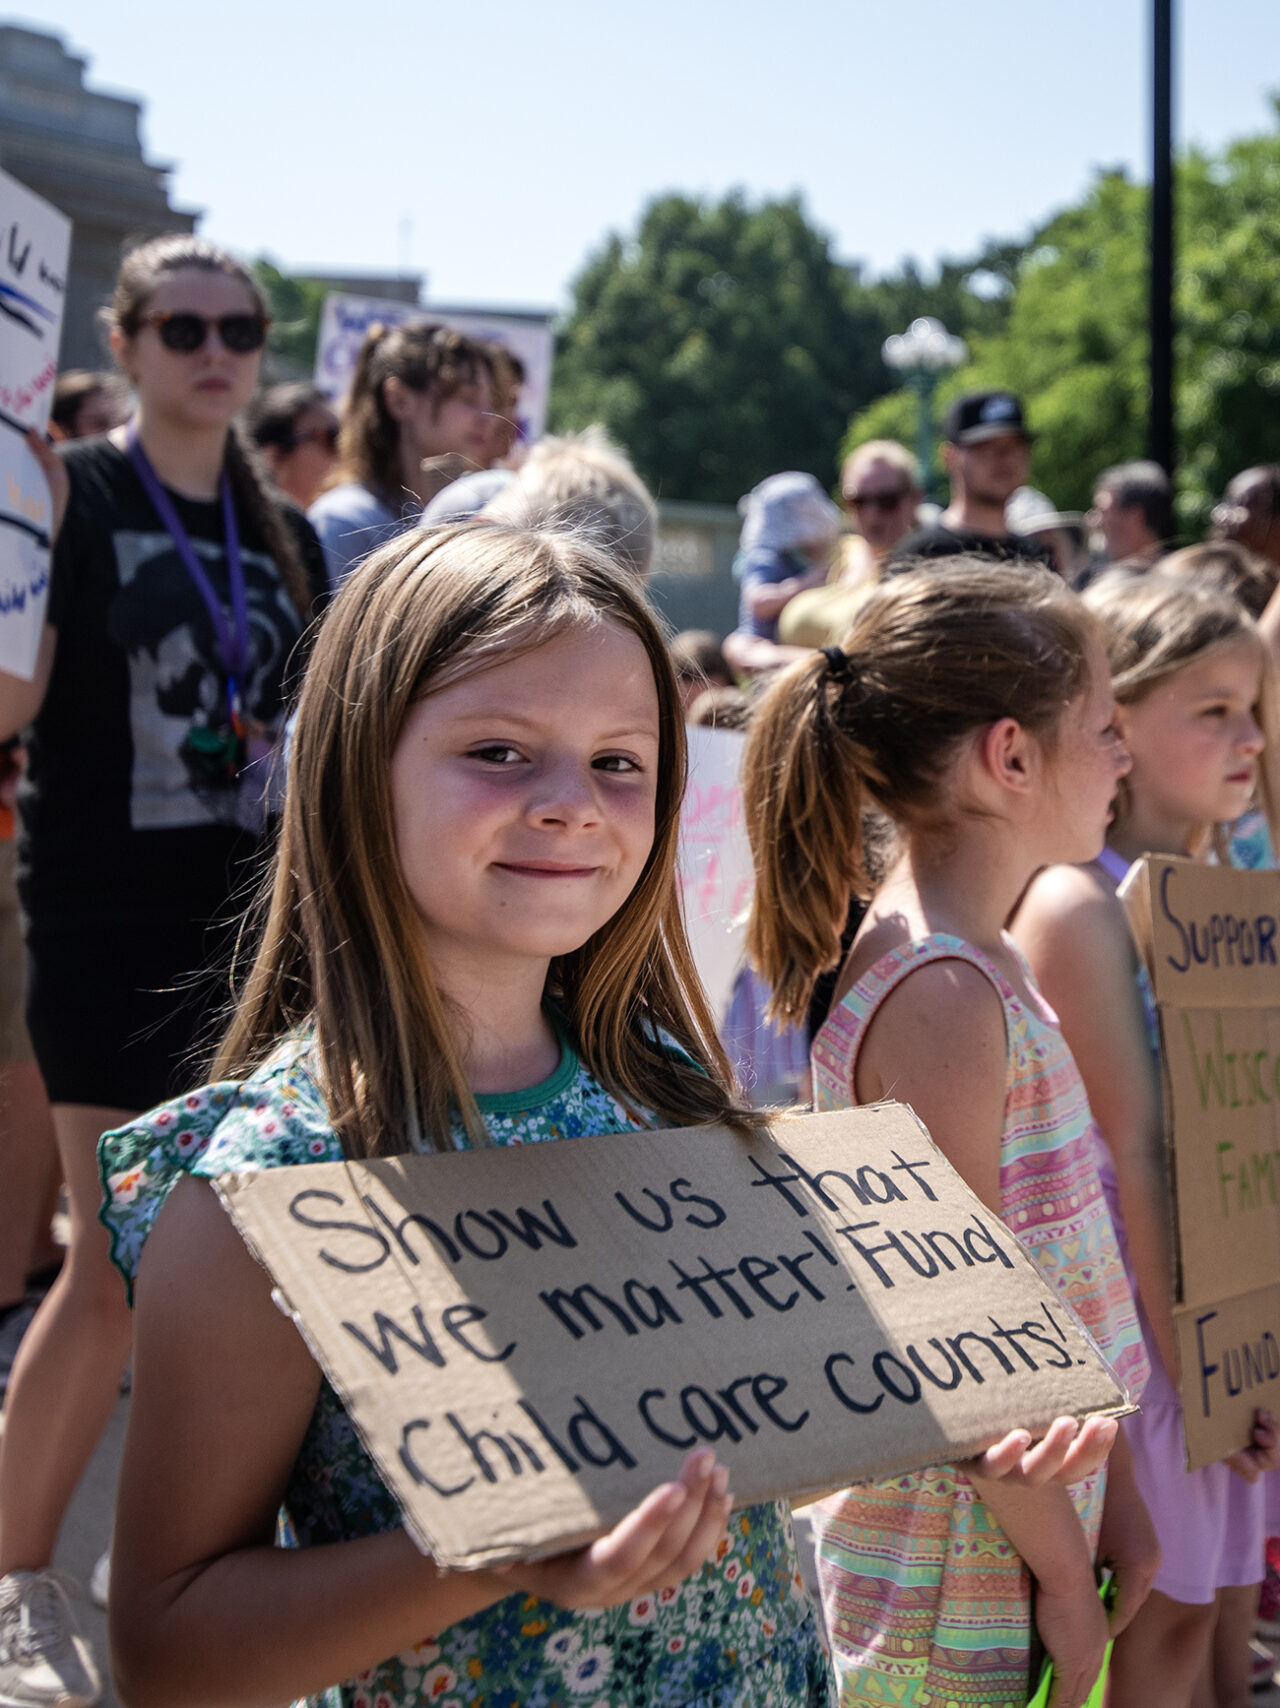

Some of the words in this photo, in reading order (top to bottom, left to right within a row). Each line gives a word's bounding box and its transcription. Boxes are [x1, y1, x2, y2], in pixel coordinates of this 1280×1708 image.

[288, 1188, 579, 1274] Show
[614, 1177, 727, 1233] us
[747, 1149, 940, 1218] that
[538, 1229, 856, 1341] matter!
[836, 1213, 1016, 1290] Fund
[1196, 1311, 1280, 1417] FUND
[396, 1393, 638, 1498] Child
[636, 1372, 810, 1451] care
